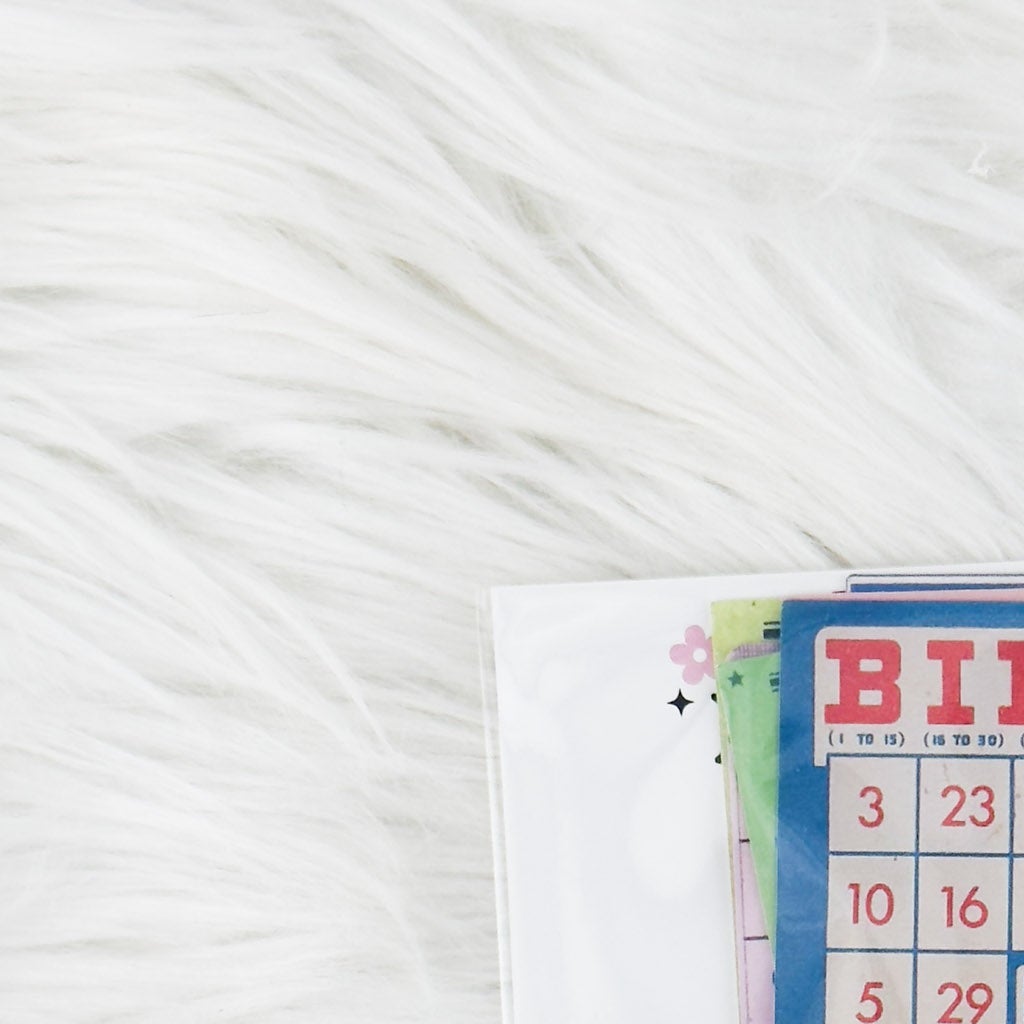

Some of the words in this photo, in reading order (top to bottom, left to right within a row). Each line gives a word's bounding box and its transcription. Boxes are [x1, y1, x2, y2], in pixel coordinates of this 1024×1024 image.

[856, 733, 874, 746] TO
[884, 732, 905, 748] 15)
[952, 733, 971, 747] TO
[977, 733, 1004, 749] 30)
[858, 786, 884, 829] 3
[941, 785, 995, 828] 23
[848, 883, 895, 927] 10
[941, 885, 988, 929] 16
[856, 982, 884, 1024] 5
